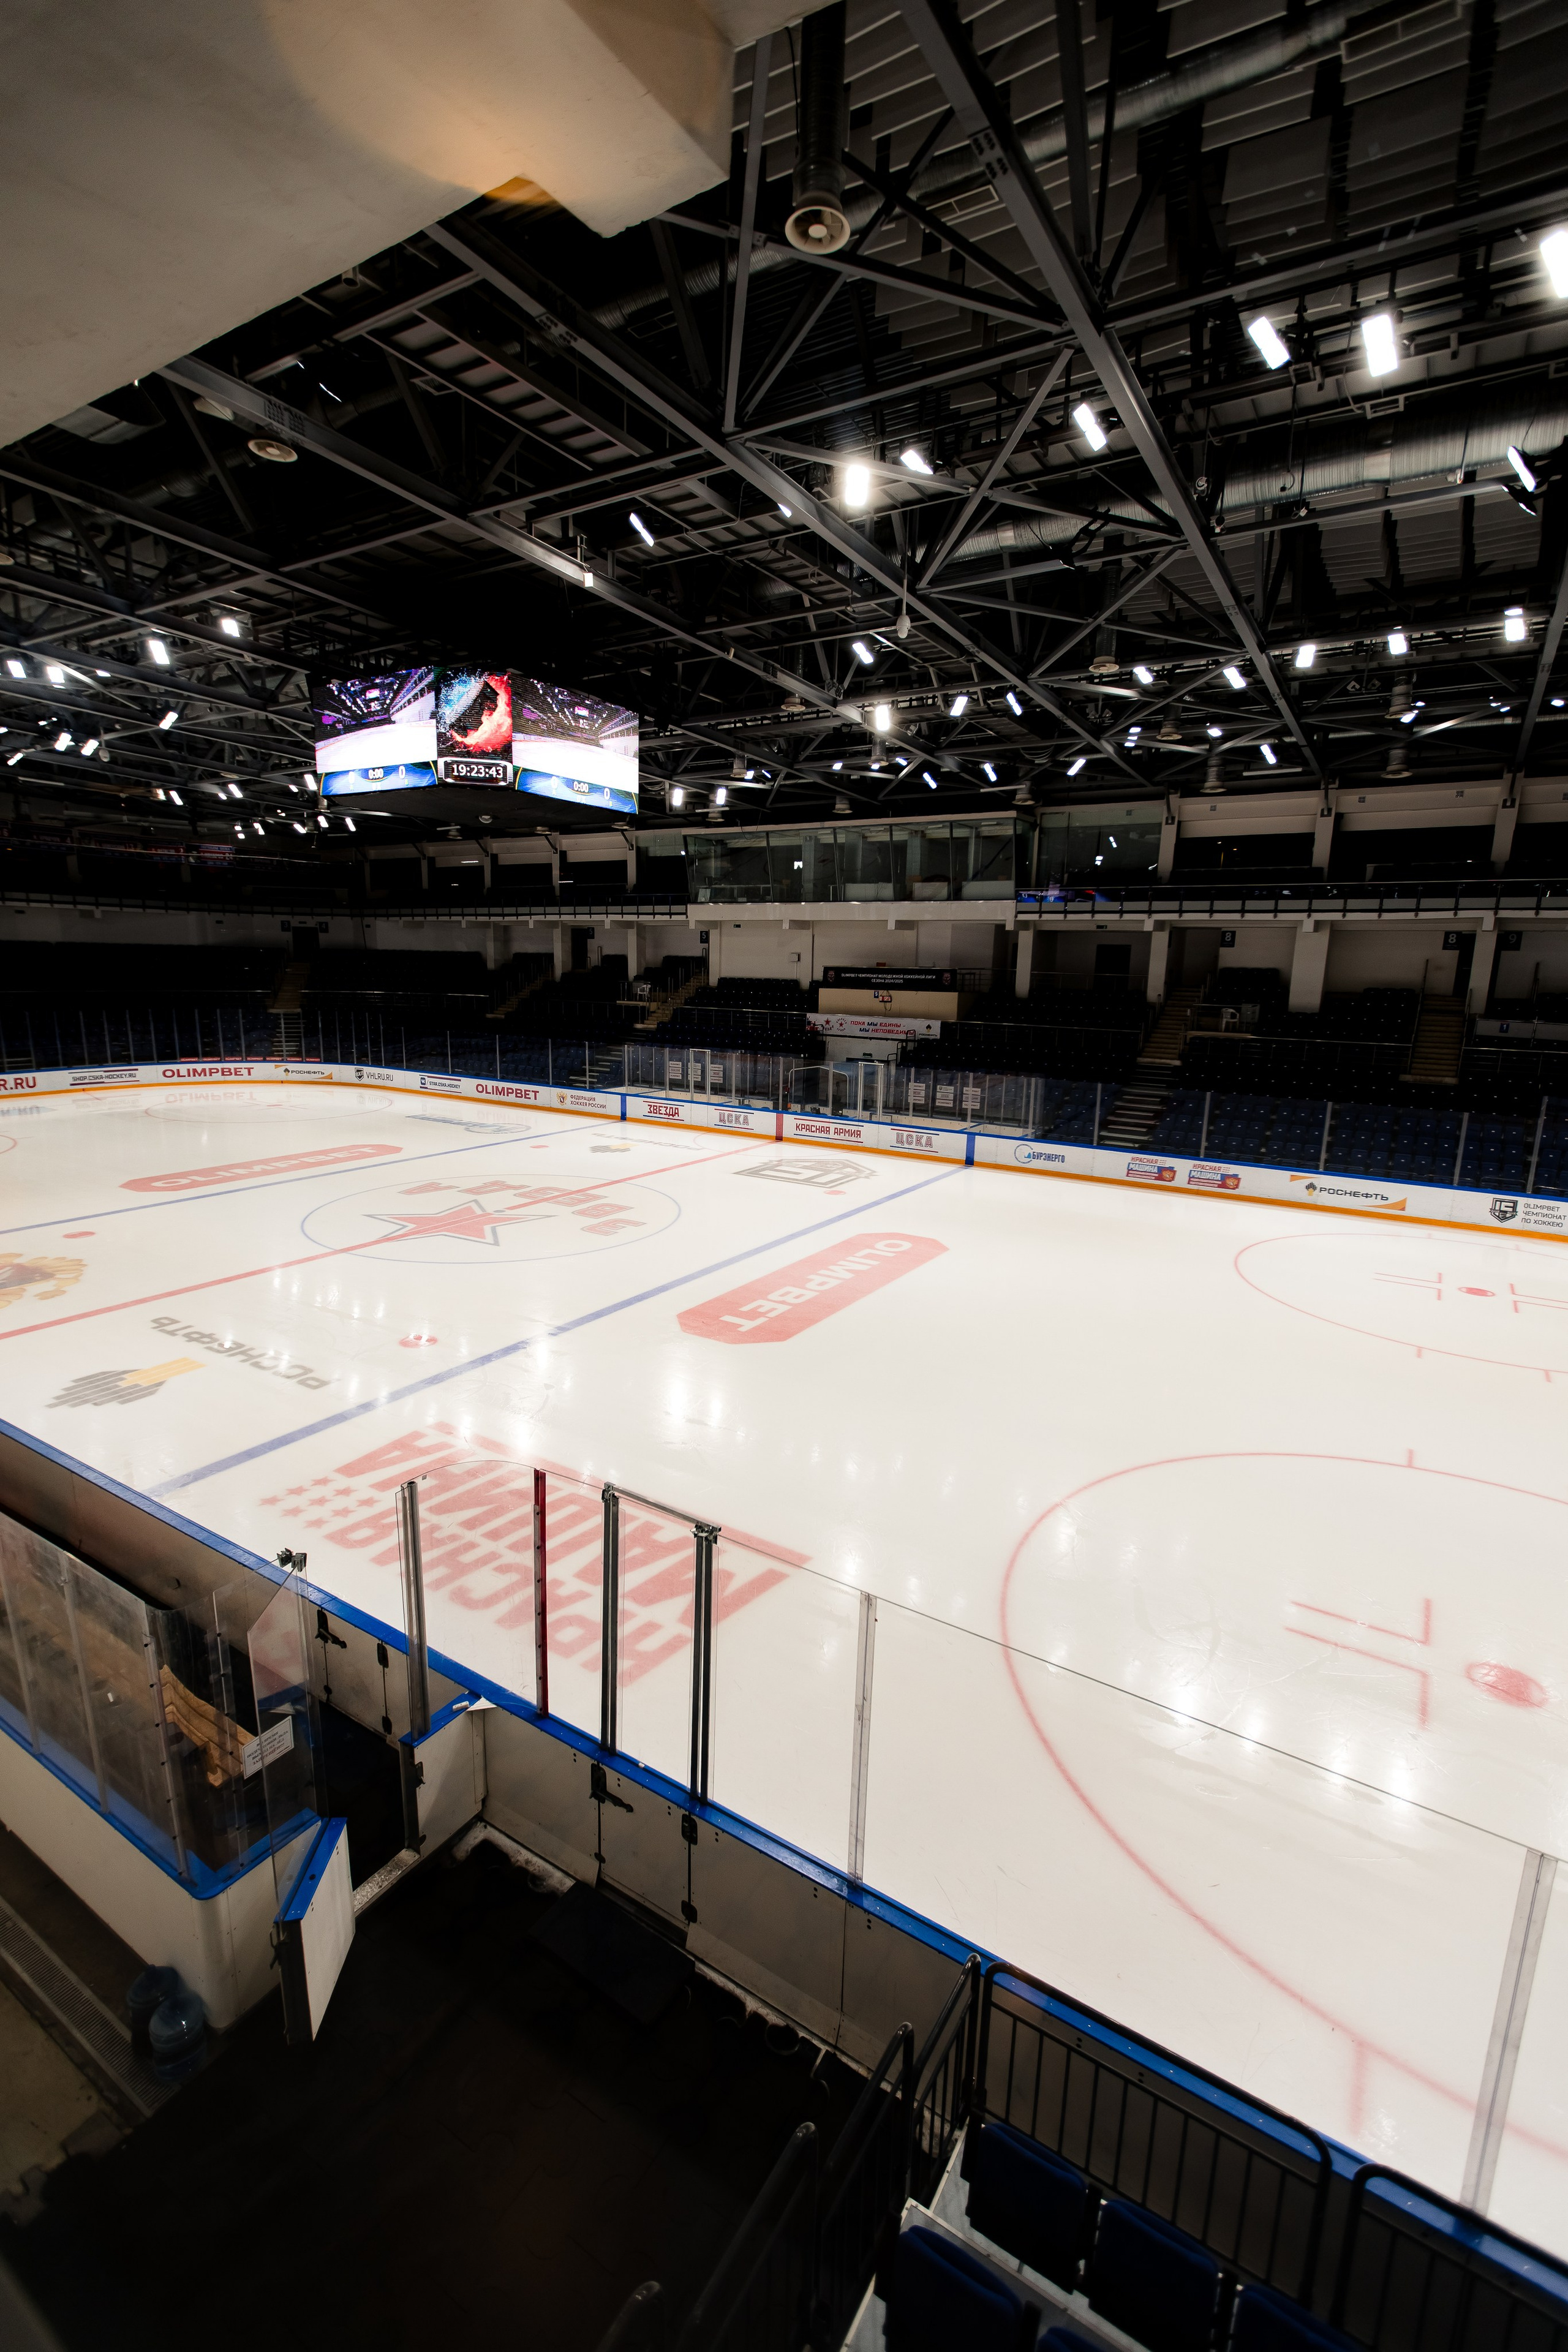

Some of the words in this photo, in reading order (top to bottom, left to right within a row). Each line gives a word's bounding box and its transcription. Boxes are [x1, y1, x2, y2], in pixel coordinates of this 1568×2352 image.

[368, 768, 383, 779] 0:00
[399, 766, 405, 779] 0
[452, 764, 503, 778] 19:23:43
[573, 781, 589, 793] 0:00
[604, 788, 610, 800] 0
[1225, 932, 1232, 941] 8
[1448, 933, 1457, 943] 8
[1509, 933, 1517, 944] 9
[72, 1072, 137, 1082] SHOP.CSKA-HOCKEY.RU
[162, 1066, 254, 1079] OLIMPBET
[366, 1071, 393, 1082] VHLRU.RU
[475, 1084, 539, 1101] OLIMPBET
[647, 1104, 680, 1118] ЗВЕЗДА
[718, 1112, 750, 1126] ЦСКА
[796, 1123, 830, 1135] КРАСНАЯ
[834, 1127, 861, 1139] АРМИЯ
[895, 1133, 933, 1148] ЦСКА
[1032, 1152, 1065, 1163] БУРЭНЕРГО
[1131, 1156, 1159, 1165] КРАСНАЯ
[151, 1147, 380, 1188] OLIMPBET
[1129, 1163, 1158, 1173] МАШИНА
[1193, 1163, 1223, 1172] КРАСНАЯ
[1190, 1170, 1221, 1181] МАШИНА
[1319, 1186, 1389, 1202] РОСНЕФТЬ
[1523, 1203, 1561, 1212] OLIMPBET
[1522, 1210, 1567, 1221] ЧЕМПИОНАТ
[1533, 1219, 1564, 1228] ХОККЕЮ
[718, 1239, 913, 1332] OLIMPBET
[150, 1316, 332, 1390] РОСНЕФТЬ
